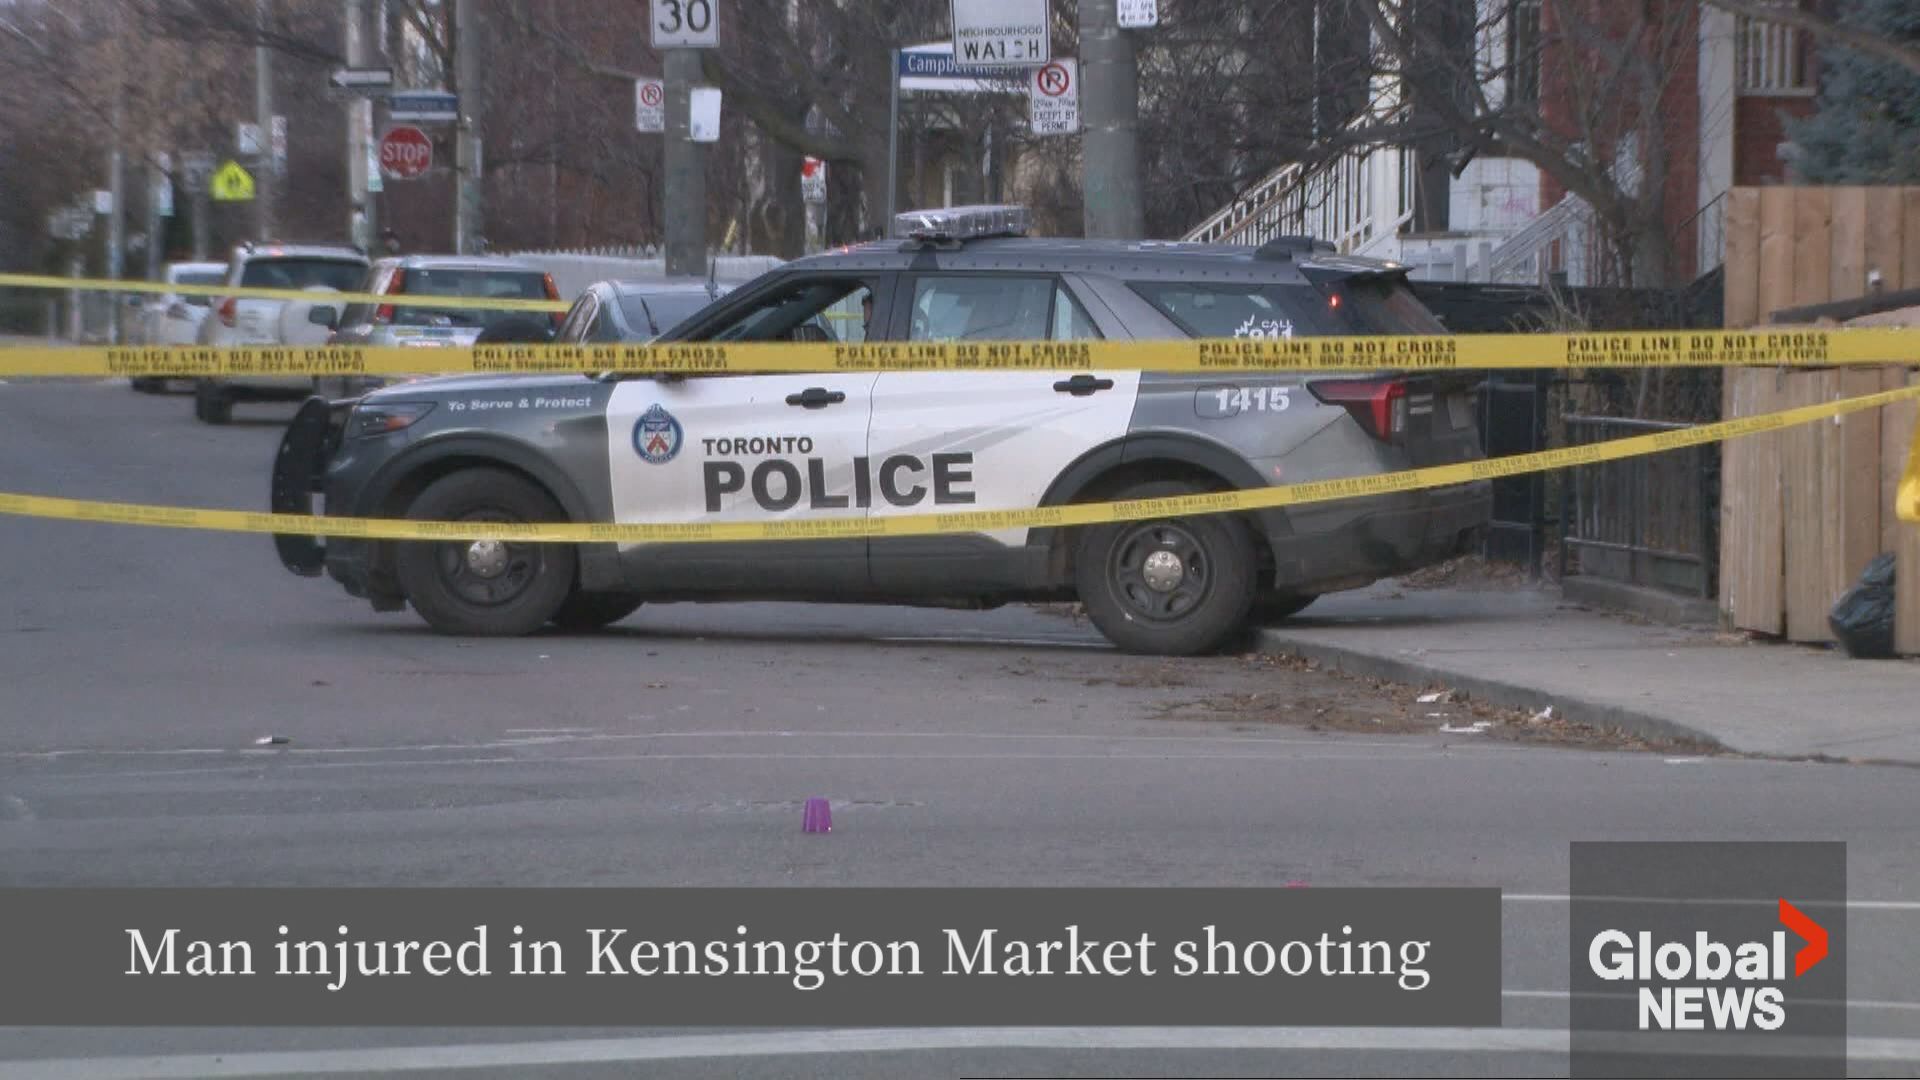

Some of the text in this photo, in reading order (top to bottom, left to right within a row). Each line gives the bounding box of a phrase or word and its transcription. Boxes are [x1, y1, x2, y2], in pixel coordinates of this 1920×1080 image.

[658, 0, 712, 33] 30
[958, 25, 1043, 37] NEIGHBOURHOOD
[908, 55, 971, 75] Campb
[1034, 111, 1075, 121] EXCEPT BY
[1042, 121, 1067, 131] PERMIT
[384, 143, 429, 161] STOP
[1261, 320, 1293, 329] CALL
[1200, 340, 1456, 354] POLICE LINE DO NOT CROSS
[1567, 334, 1828, 351] POLICE LINE DO NOT CROSS
[448, 397, 592, 411] To Serve & Protect
[1216, 387, 1290, 411] 1415
[702, 436, 813, 456] TORONTO
[704, 452, 976, 512] POLICE
